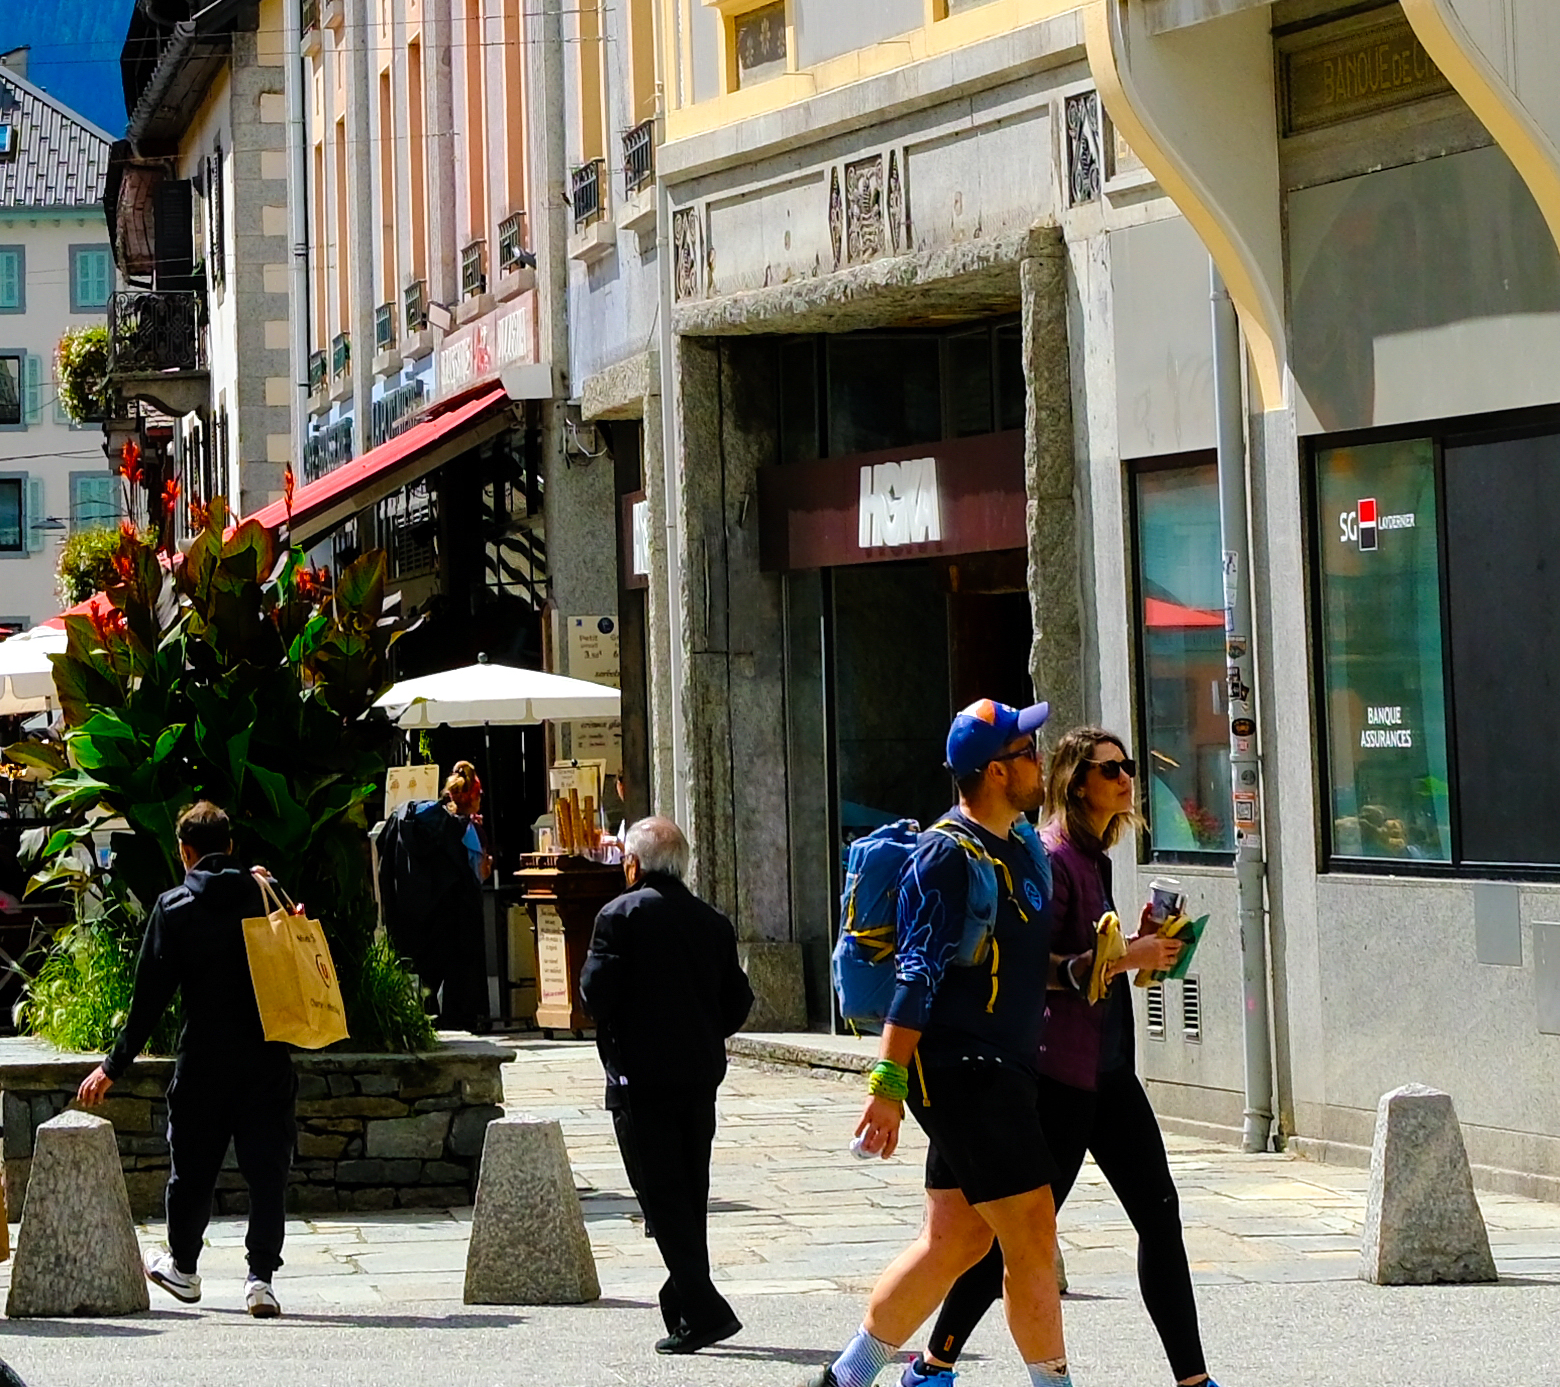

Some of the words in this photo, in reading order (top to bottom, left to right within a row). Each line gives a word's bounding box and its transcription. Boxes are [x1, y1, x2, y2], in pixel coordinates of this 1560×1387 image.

[1339, 511, 1358, 543] SG
[1367, 706, 1402, 726] BANQUE
[1360, 729, 1412, 748] ASSURANCES
